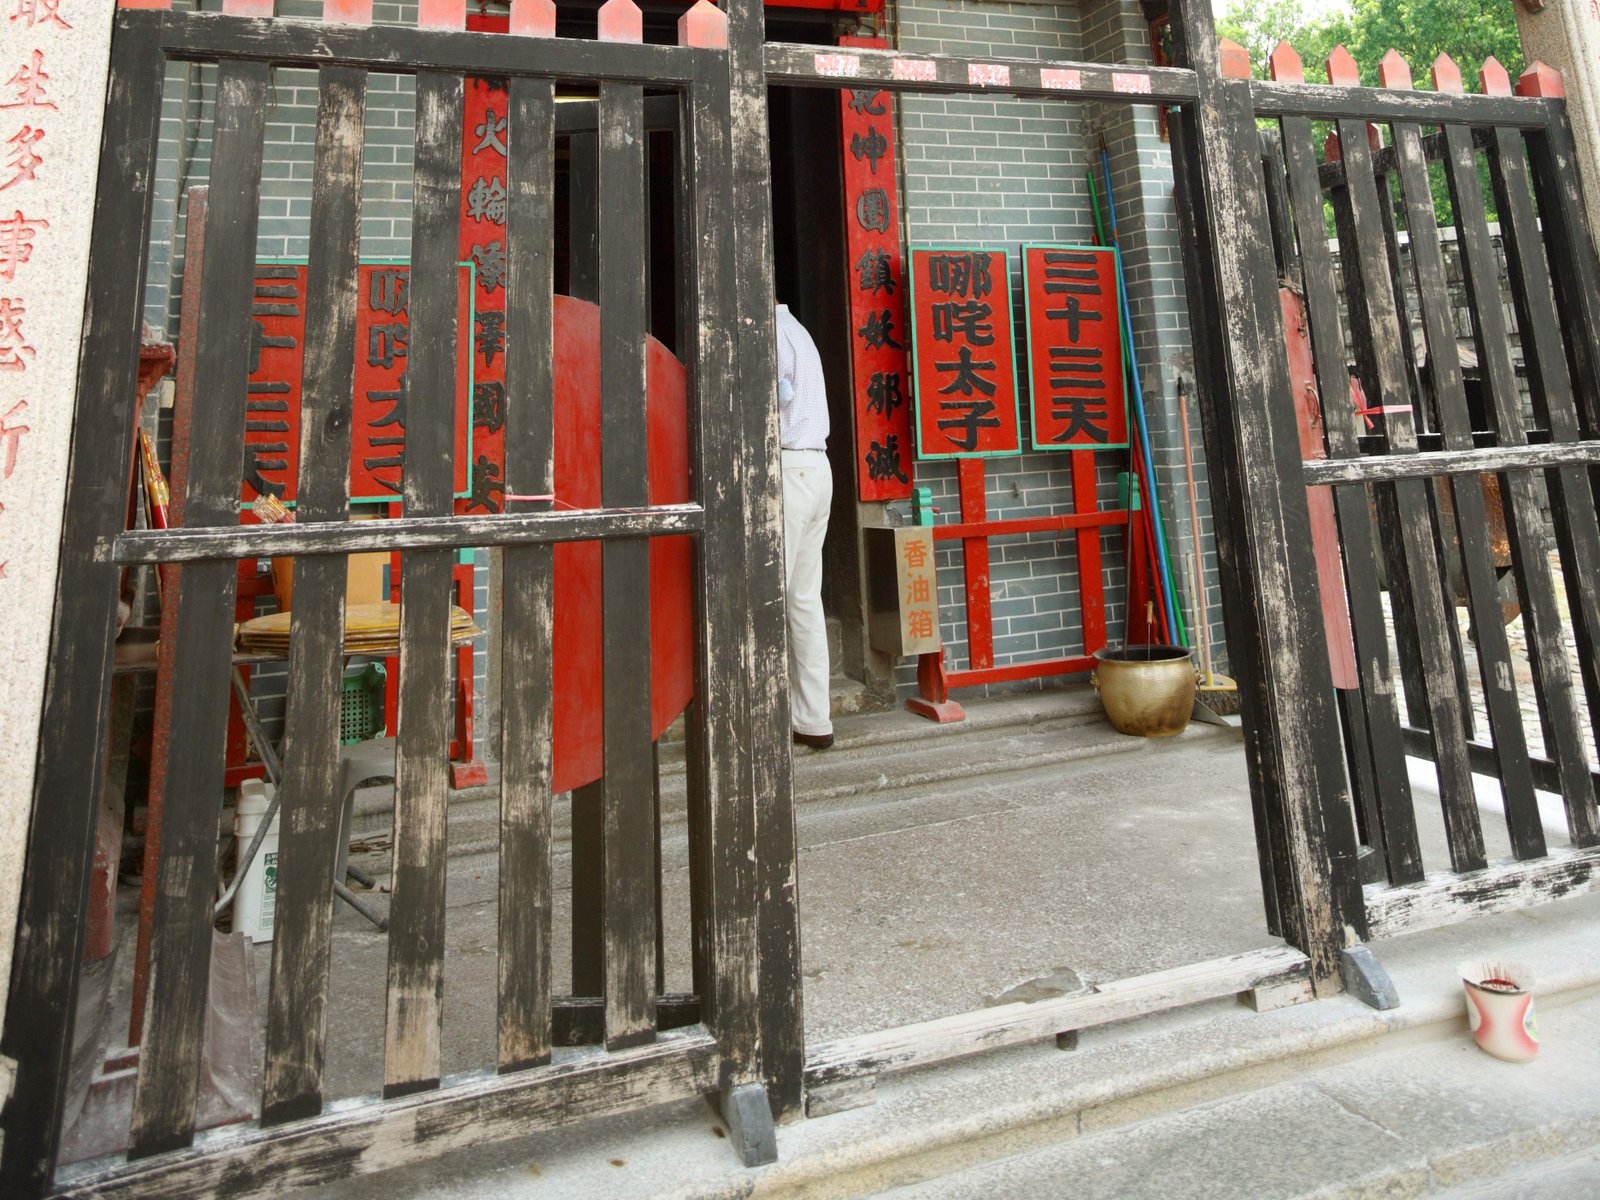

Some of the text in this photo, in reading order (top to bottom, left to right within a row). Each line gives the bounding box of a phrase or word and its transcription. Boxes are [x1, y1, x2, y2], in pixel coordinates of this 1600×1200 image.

[1043, 252, 1109, 443] 三十三天
[903, 539, 933, 639] 香油箱
